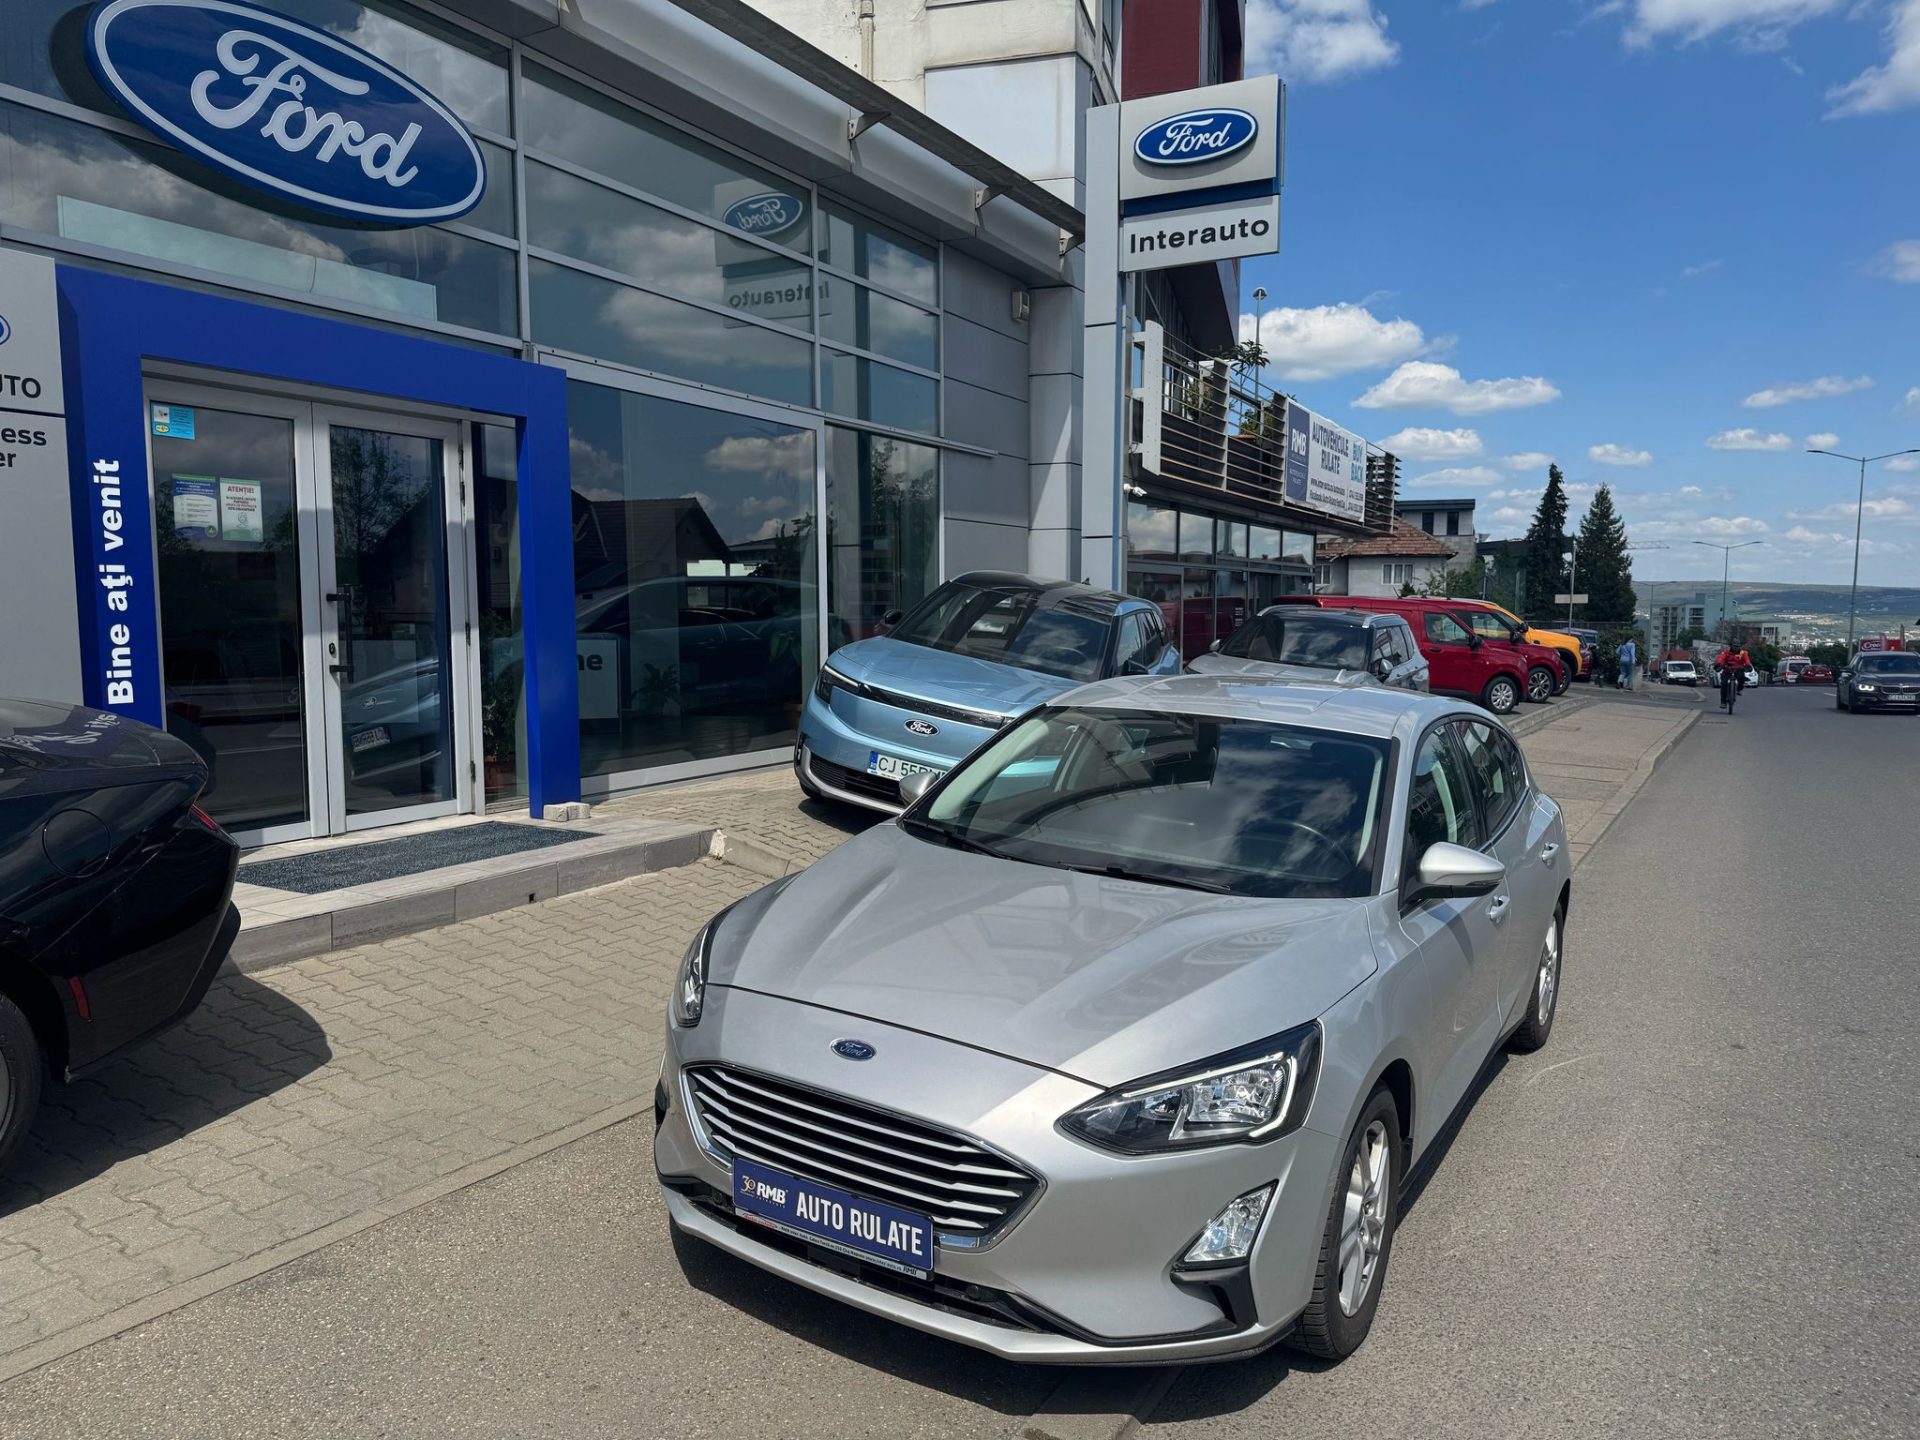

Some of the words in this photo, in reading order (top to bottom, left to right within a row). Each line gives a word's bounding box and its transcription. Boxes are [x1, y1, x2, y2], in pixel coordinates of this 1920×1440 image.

[191, 30, 422, 187] Ford
[1159, 118, 1232, 156] Ford
[1130, 218, 1269, 253] Interauto
[0, 373, 41, 399] TO
[1291, 428, 1307, 456] RMB
[1321, 449, 1340, 475] RULATE
[93, 459, 123, 552] venit
[107, 623, 134, 704] Bine
[910, 721, 933, 734] Ford
[878, 757, 897, 773] CJ
[757, 1182, 786, 1204] RMB
[796, 1192, 844, 1230] AUTO
[850, 1208, 923, 1256] RULATE
